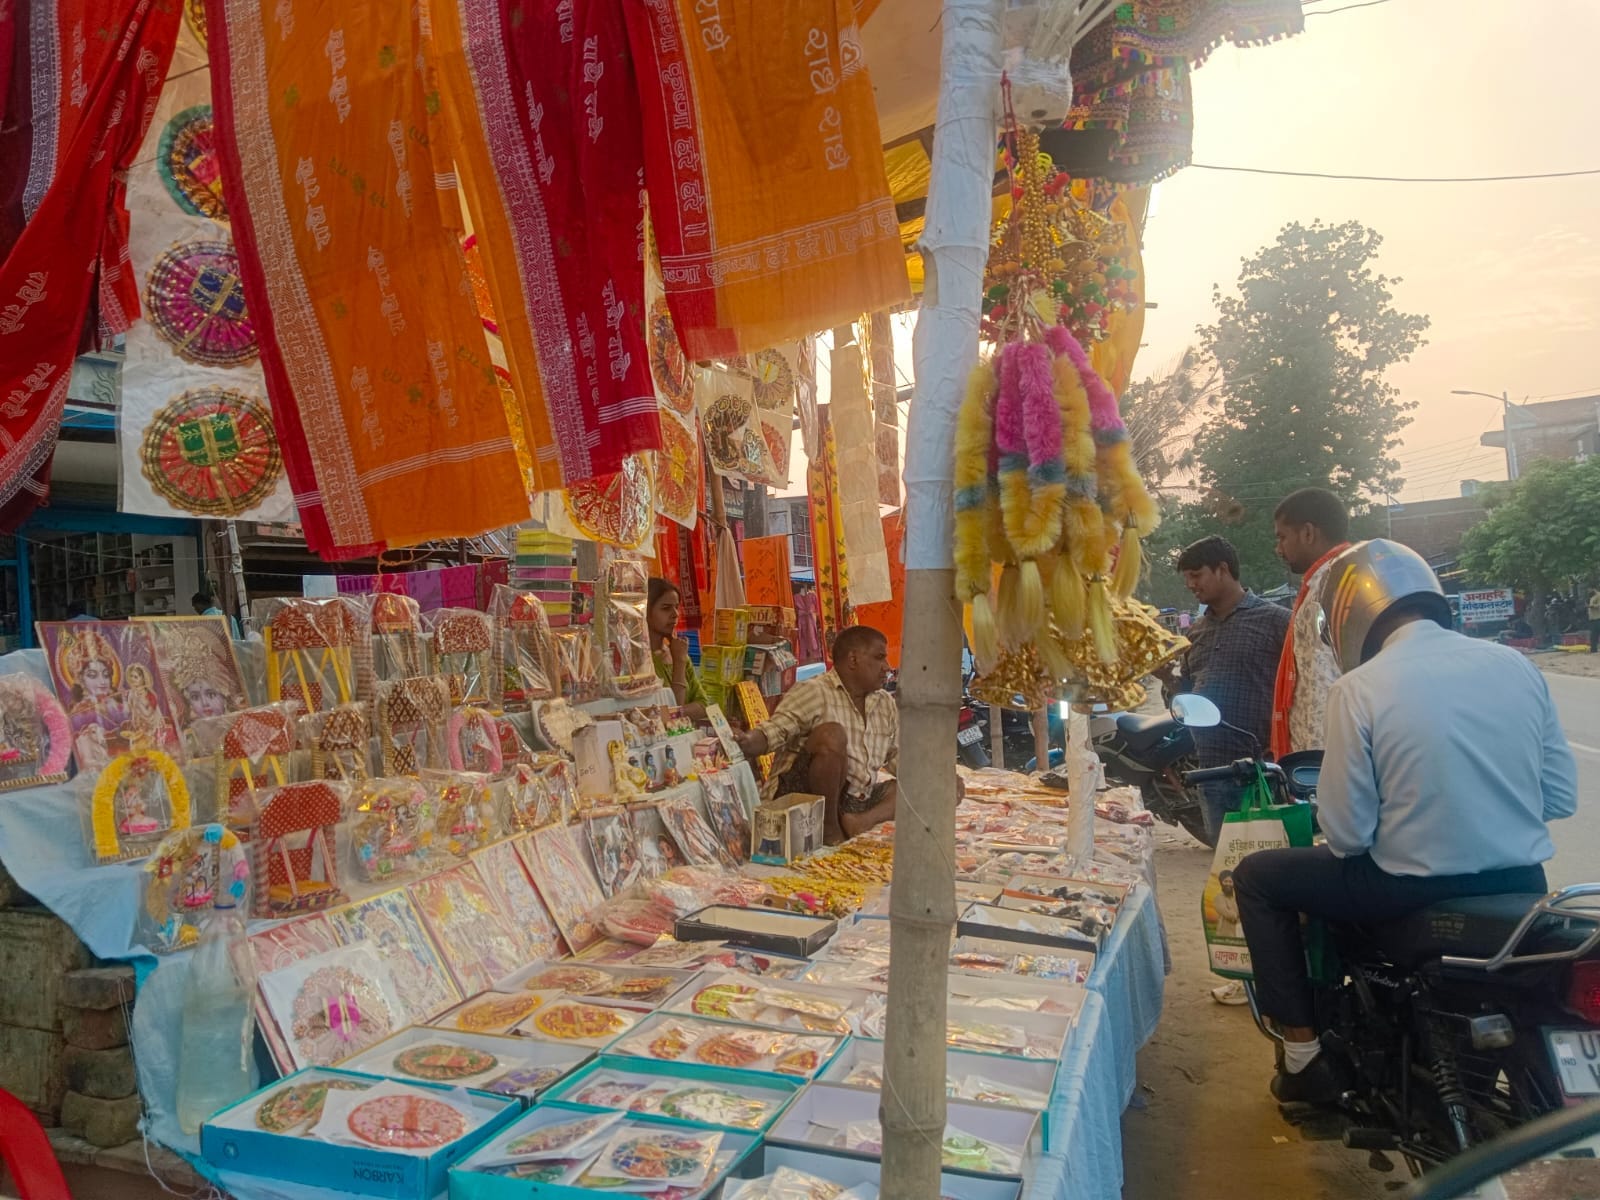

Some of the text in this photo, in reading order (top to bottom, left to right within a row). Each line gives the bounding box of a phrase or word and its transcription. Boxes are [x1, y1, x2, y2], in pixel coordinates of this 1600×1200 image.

[804, 28, 841, 94] राधे
[583, 35, 604, 144] राधे राधे
[676, 136, 700, 171] हरे
[819, 106, 851, 170] राधे
[680, 180, 705, 213] हरे
[764, 239, 790, 270] हरे
[797, 229, 820, 260] हरे
[602, 280, 631, 382] राधे राधे
[1560, 1057, 1577, 1066] IND
[1577, 1033, 1600, 1061] U
[353, 1167, 405, 1185] KARBON
